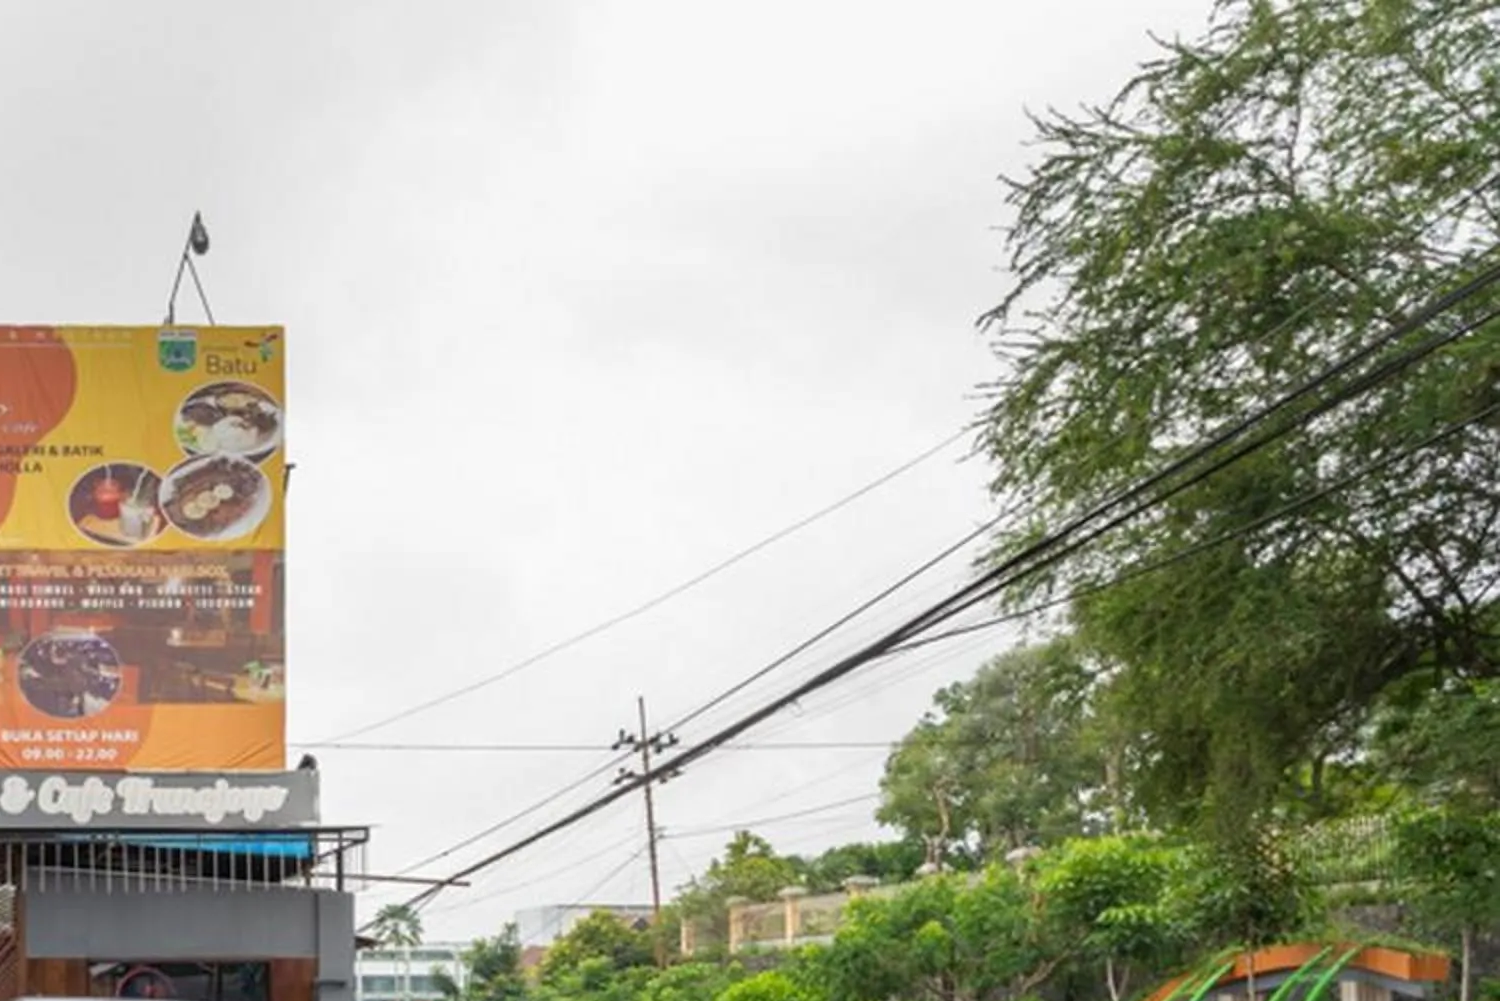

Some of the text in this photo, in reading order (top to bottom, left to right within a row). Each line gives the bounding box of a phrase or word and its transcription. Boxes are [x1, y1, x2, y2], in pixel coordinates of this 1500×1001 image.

[206, 353, 257, 375] Batu
[48, 444, 60, 457] &
[63, 444, 105, 457] BATIK
[1, 729, 140, 742] BUKA SETIAP HARI
[21, 748, 65, 761] 09.00
[75, 748, 118, 761] 22.00
[0, 775, 36, 814] &
[37, 775, 115, 824] Cafe
